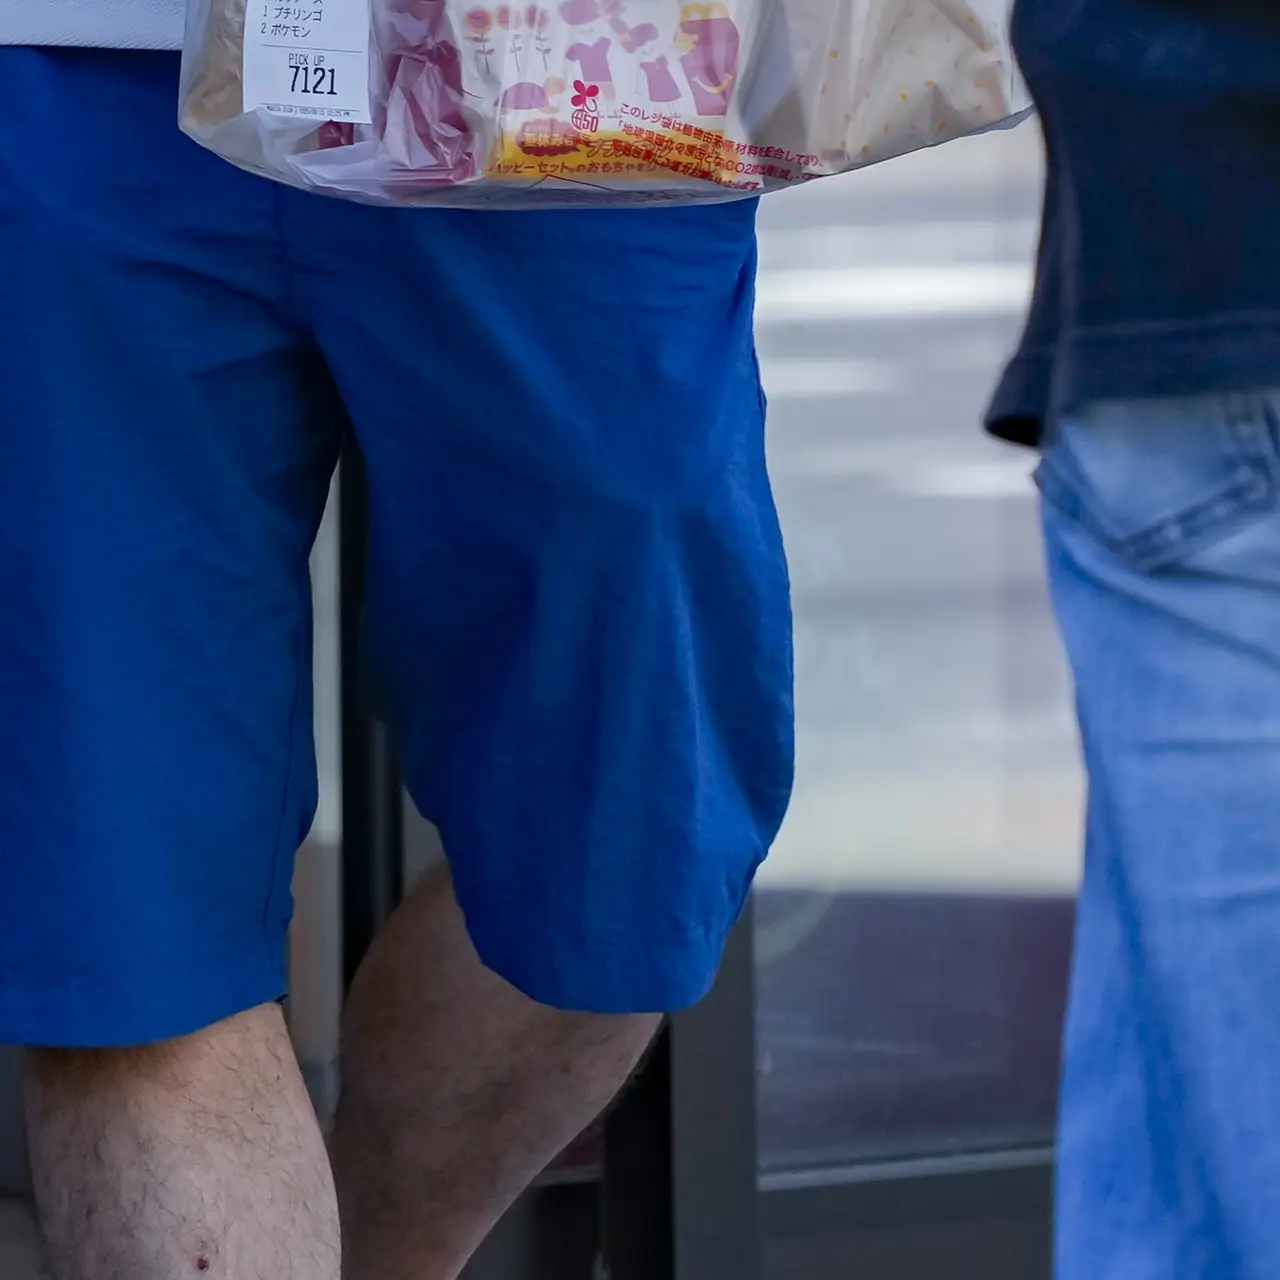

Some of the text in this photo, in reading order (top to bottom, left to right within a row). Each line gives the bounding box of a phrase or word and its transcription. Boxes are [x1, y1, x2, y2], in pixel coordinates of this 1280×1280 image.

[261, 22, 311, 38] 2 ポケモン
[288, 53, 325, 66] PICK UP
[289, 65, 338, 95] 7121
